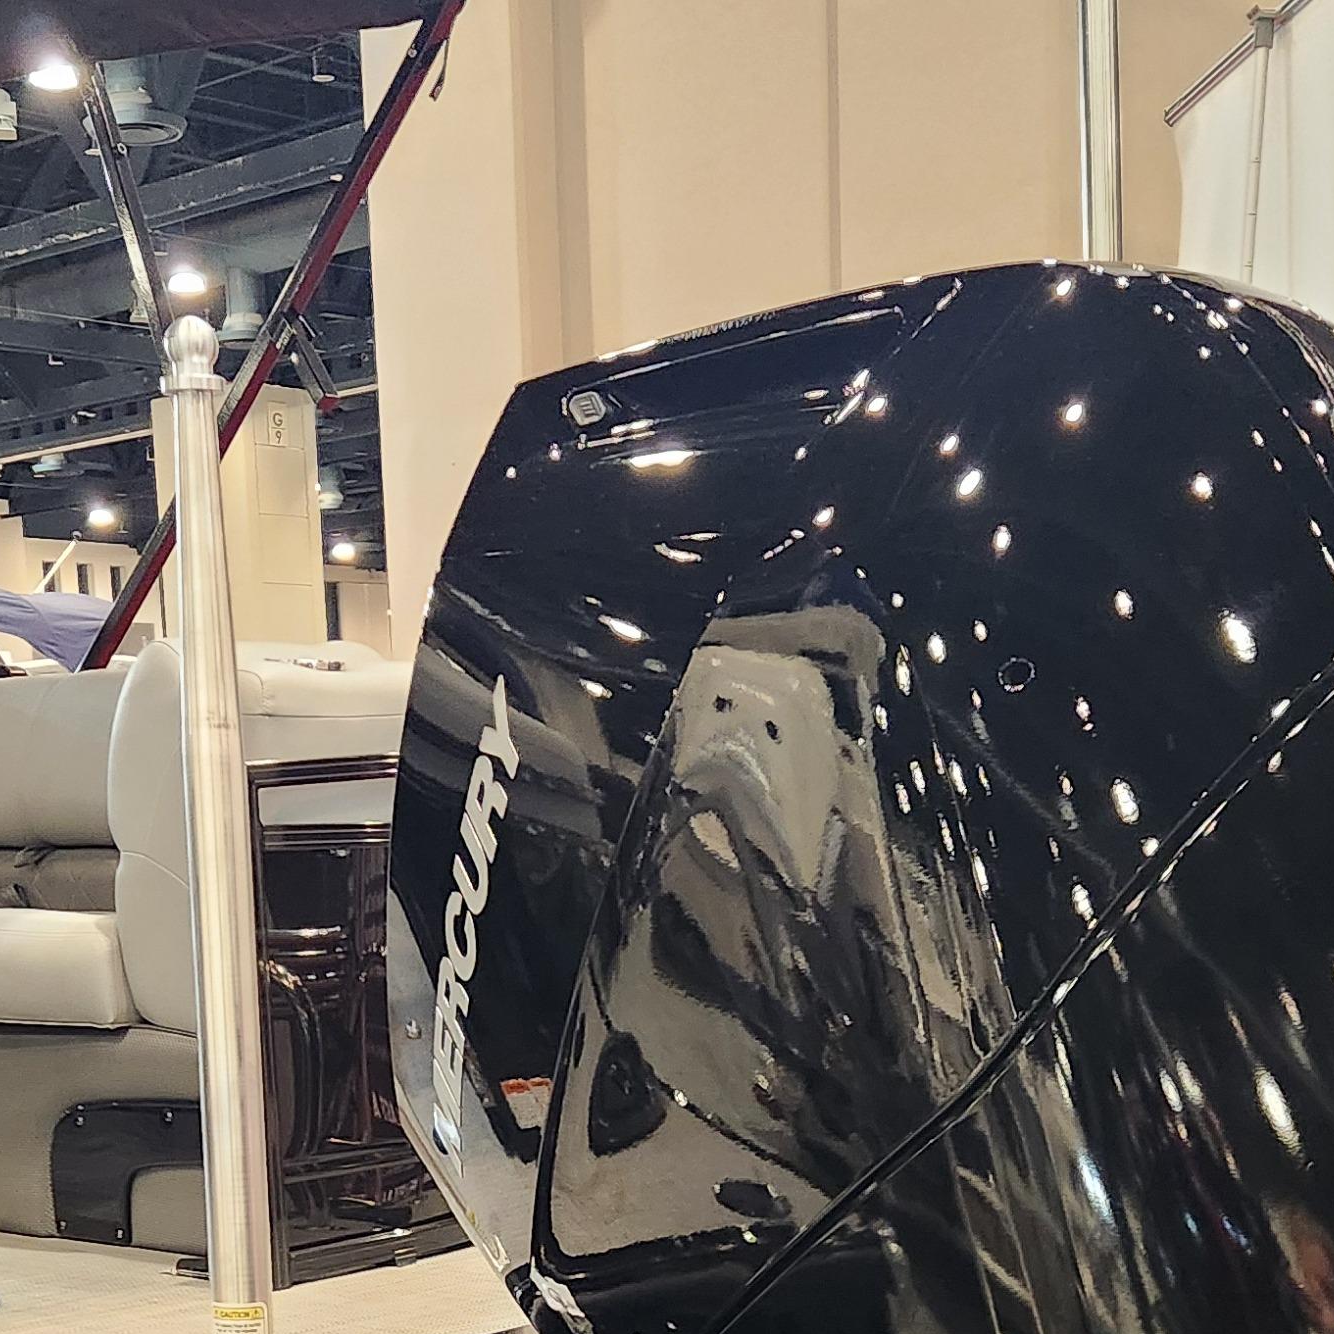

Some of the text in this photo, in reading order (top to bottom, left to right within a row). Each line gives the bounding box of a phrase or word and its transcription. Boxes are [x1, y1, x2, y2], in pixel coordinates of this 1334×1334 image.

[273, 412, 283, 427] G
[275, 430, 282, 444] 9
[432, 674, 519, 1178] MERCURY
